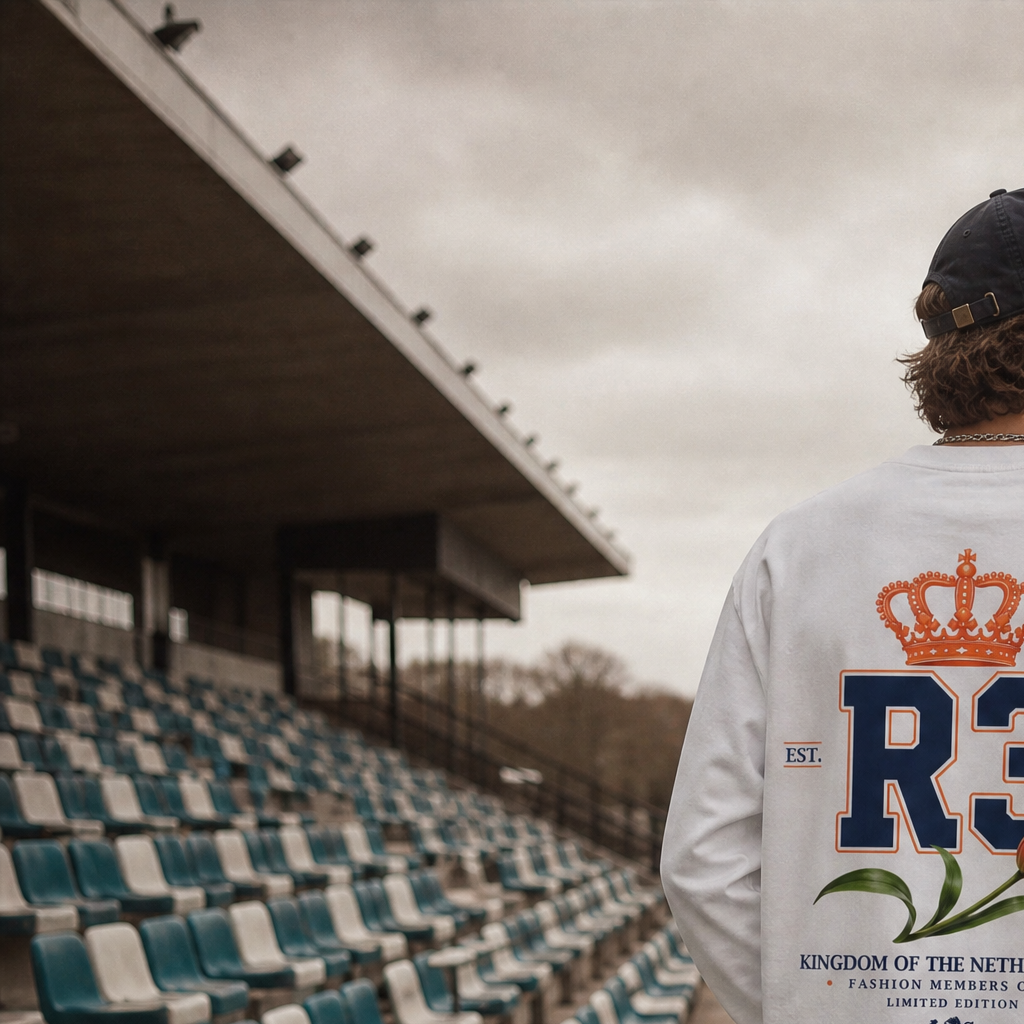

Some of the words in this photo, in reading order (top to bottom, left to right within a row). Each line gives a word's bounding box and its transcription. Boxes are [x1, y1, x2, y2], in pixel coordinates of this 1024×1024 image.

[785, 747, 822, 763] EST.
[799, 953, 889, 972] KINGDOM
[893, 954, 920, 972] OF
[925, 955, 965, 973] THE
[848, 978, 922, 990] FASHION
[929, 979, 1009, 992] MEMBERS
[886, 997, 948, 1008] LIMITED
[954, 998, 1018, 1010] EDITION
